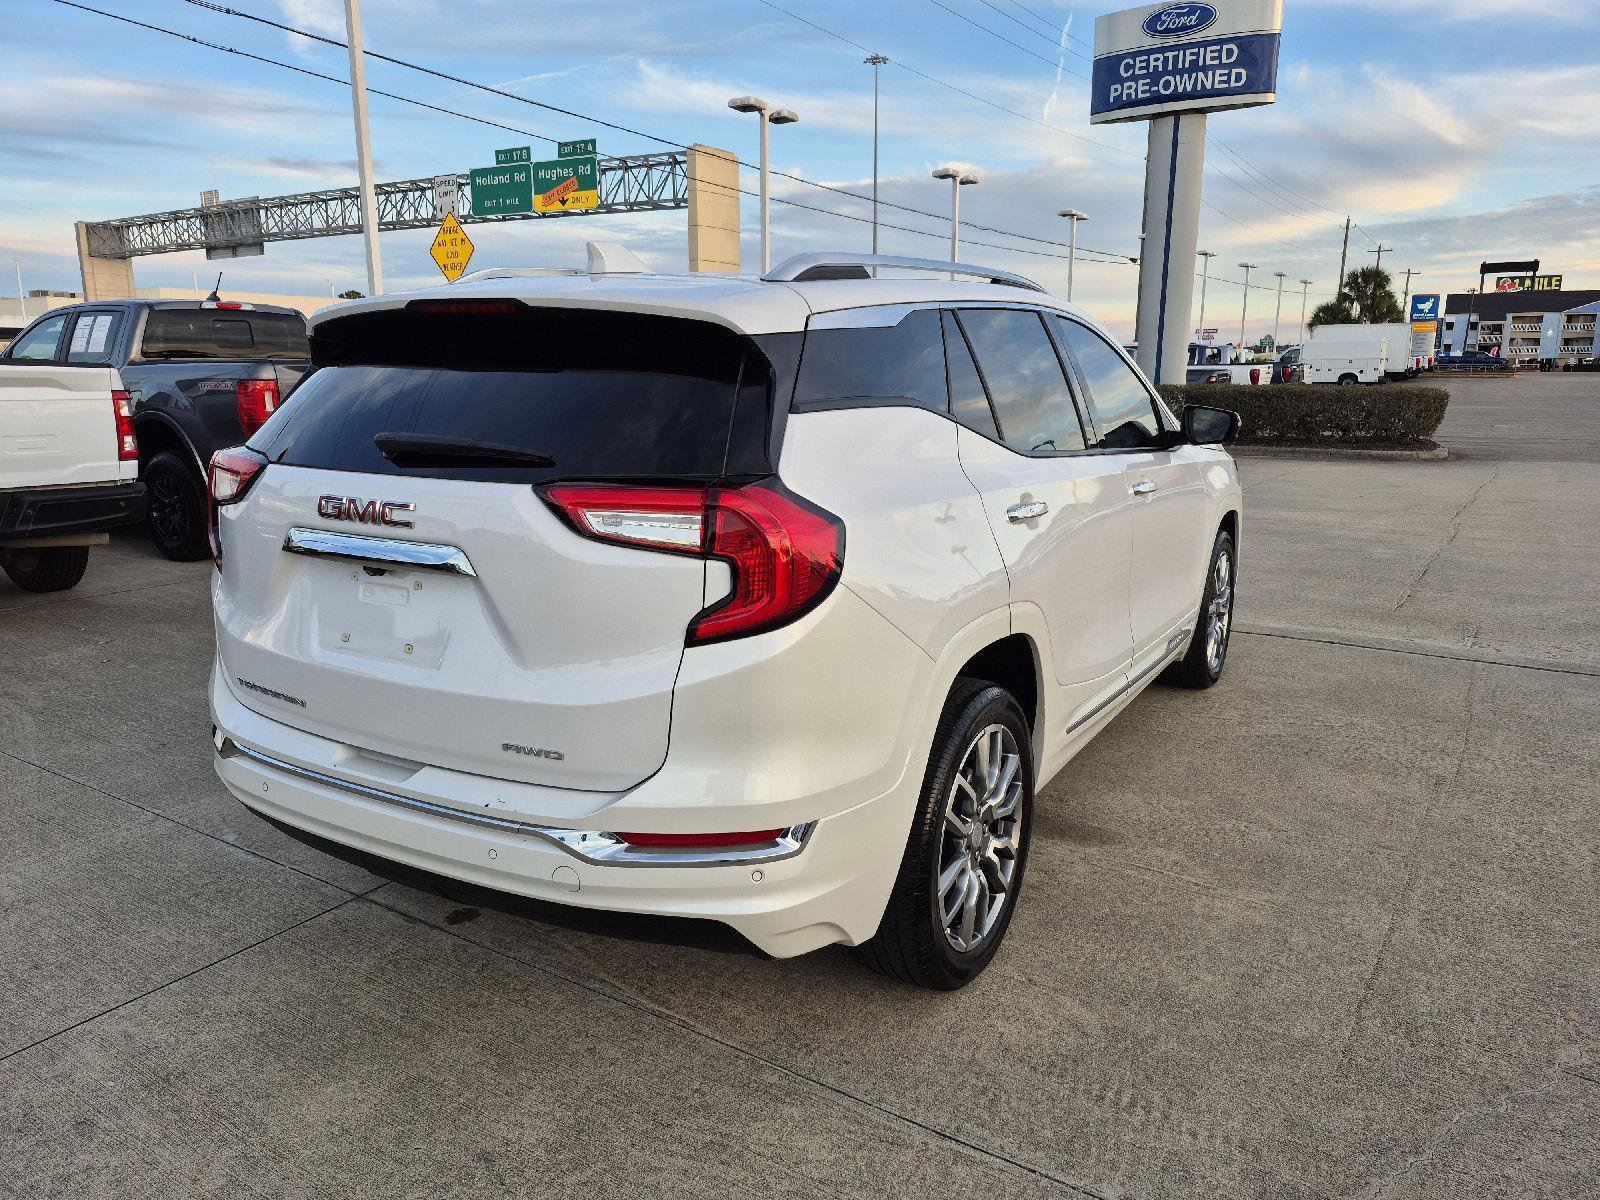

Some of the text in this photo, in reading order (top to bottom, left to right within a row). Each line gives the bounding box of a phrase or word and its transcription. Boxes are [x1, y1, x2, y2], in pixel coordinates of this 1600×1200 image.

[1156, 7, 1201, 31] Ford
[1119, 43, 1239, 78] CERTIFIED
[1109, 67, 1248, 103] PRE-OWNED
[498, 153, 510, 161] EXIT
[475, 172, 526, 186] Holland Rd
[538, 164, 591, 181] Hughes Rd
[436, 179, 456, 188] SPEED
[439, 190, 454, 198] LIMIT
[571, 195, 590, 204] ONLY
[484, 199, 496, 207] EXIT
[506, 197, 520, 206] MILE
[317, 494, 417, 530] GMC
[502, 743, 564, 760] AWD
